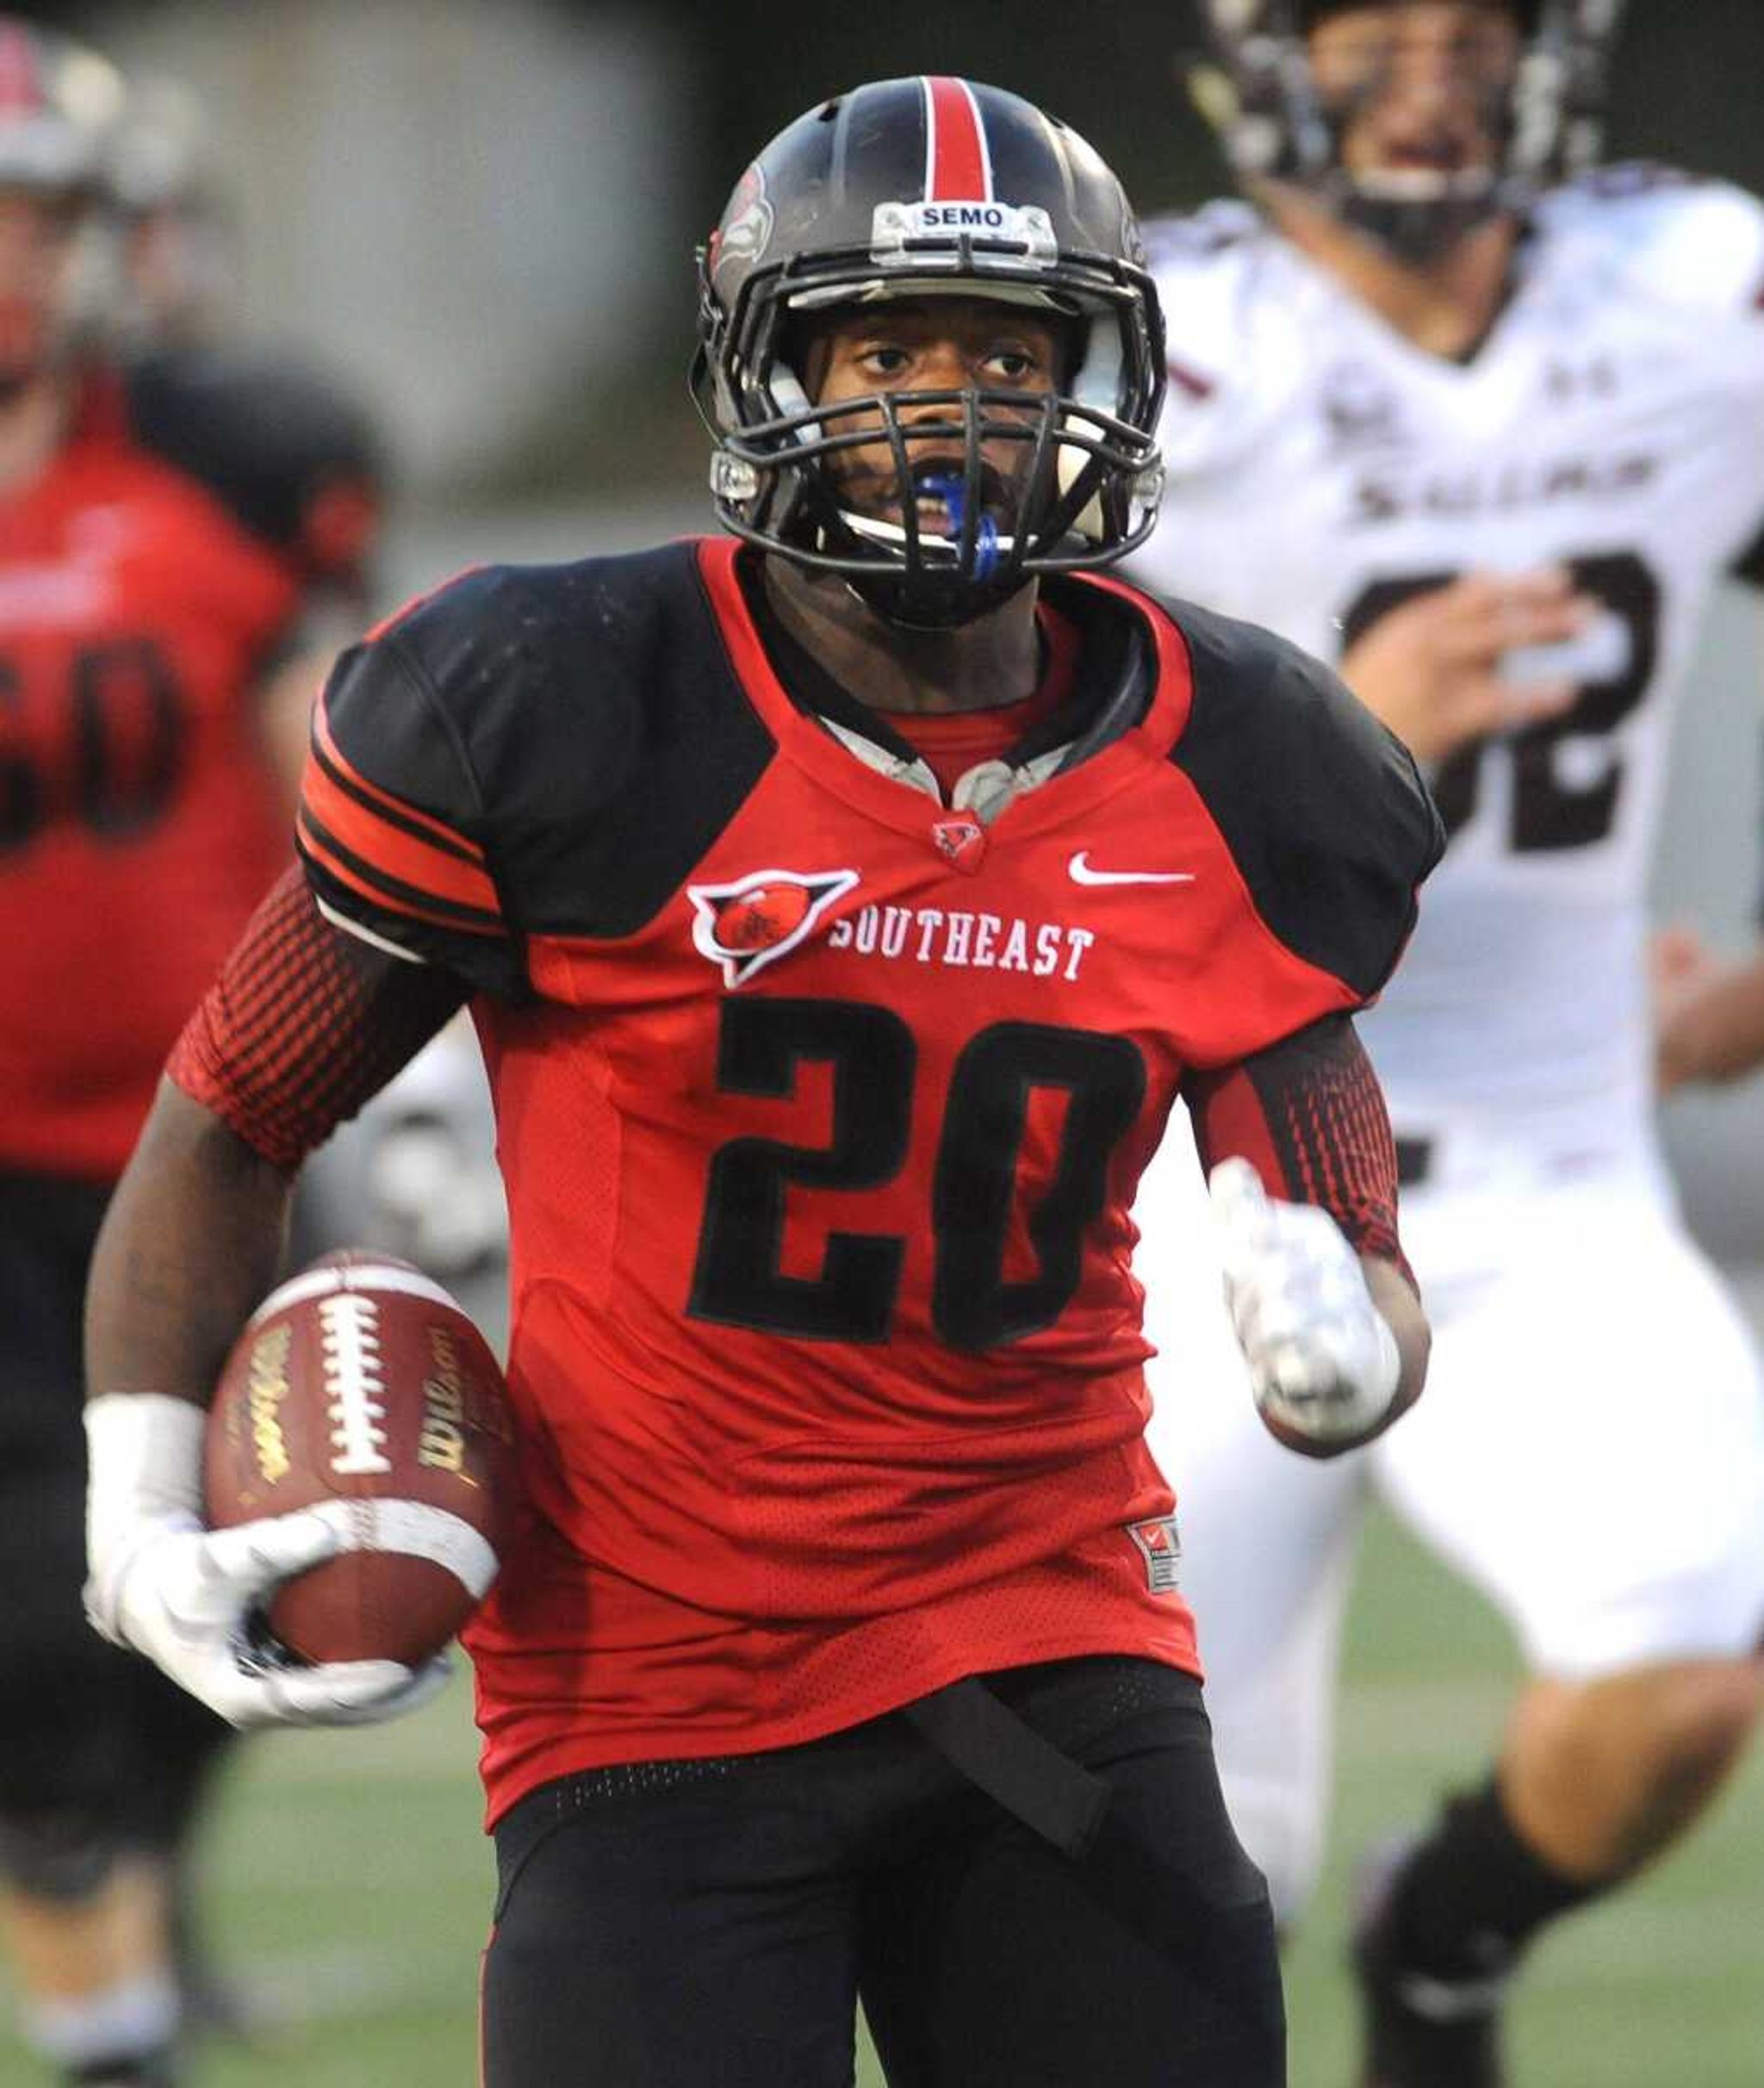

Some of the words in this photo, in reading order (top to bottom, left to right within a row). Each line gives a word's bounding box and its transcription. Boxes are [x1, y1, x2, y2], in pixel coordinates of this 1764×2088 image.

[922, 208, 1003, 227] SEMO
[828, 903, 1096, 982] SOUTHEAST
[686, 996, 1149, 1356] 20
[417, 1321, 467, 1472] Wilson
